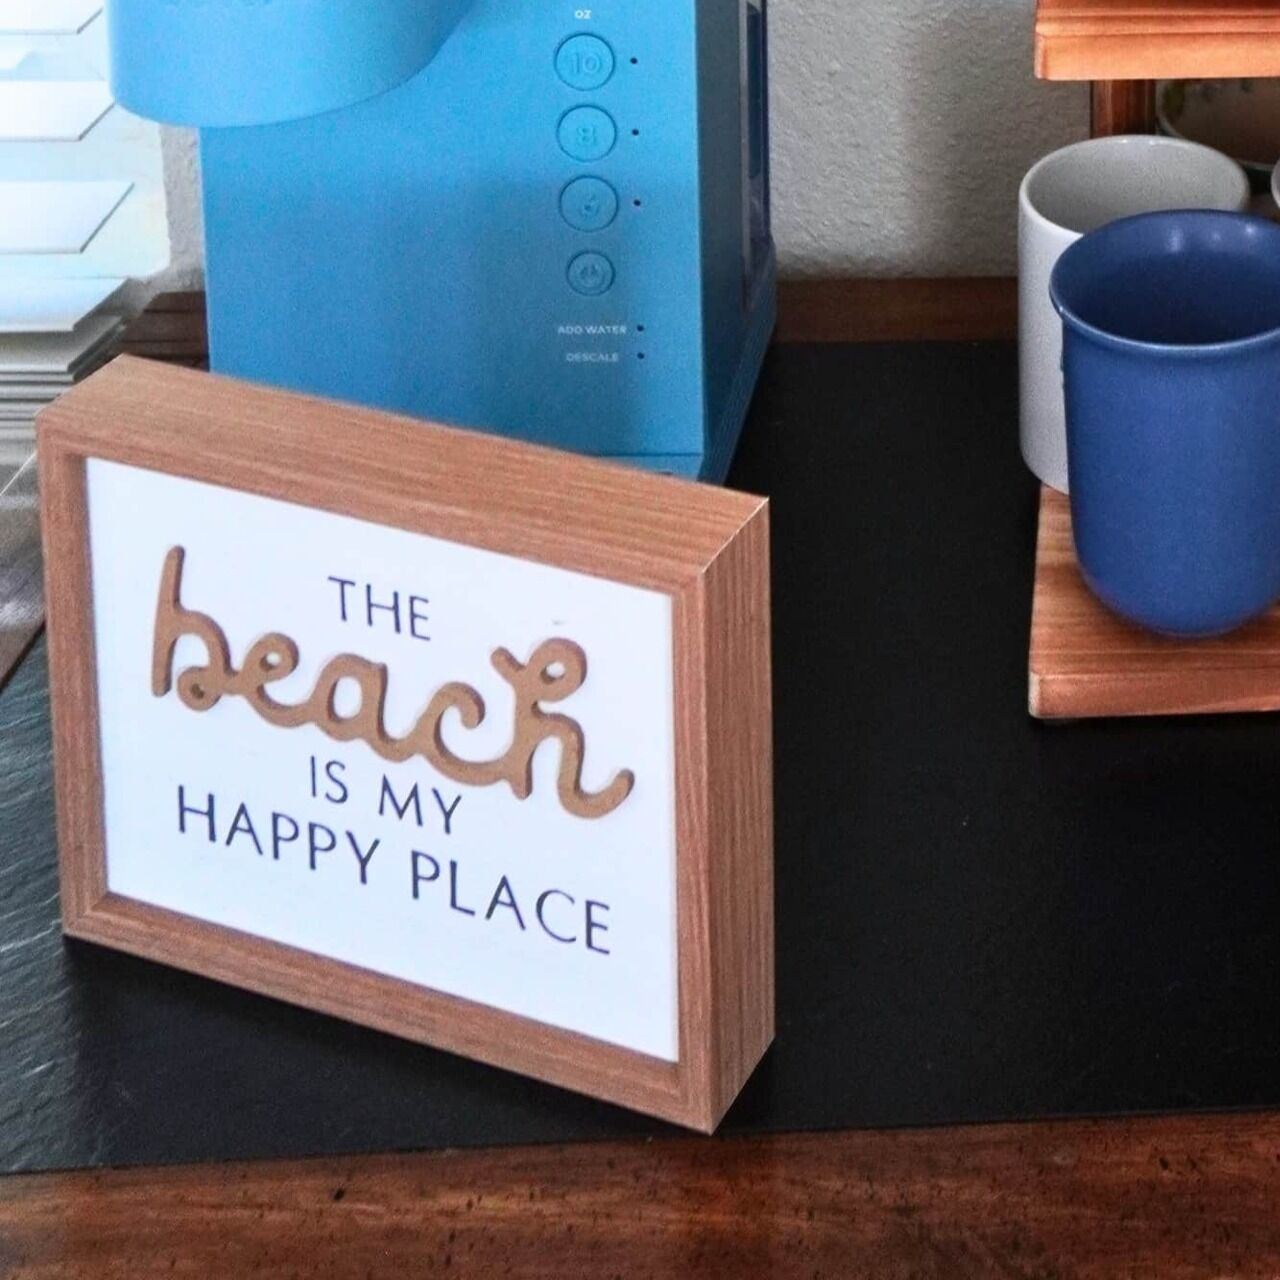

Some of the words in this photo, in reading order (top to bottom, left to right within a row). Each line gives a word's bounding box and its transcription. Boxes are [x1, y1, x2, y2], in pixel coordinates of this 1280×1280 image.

[558, 325, 583, 335] ADD
[584, 325, 627, 335] WATER
[566, 352, 619, 362] DESCALE
[327, 575, 431, 641] THE
[151, 544, 636, 819] beach
[310, 755, 349, 804] IS
[379, 773, 462, 835] MY
[177, 784, 381, 885] HAPPY
[411, 849, 611, 955] PLACE
